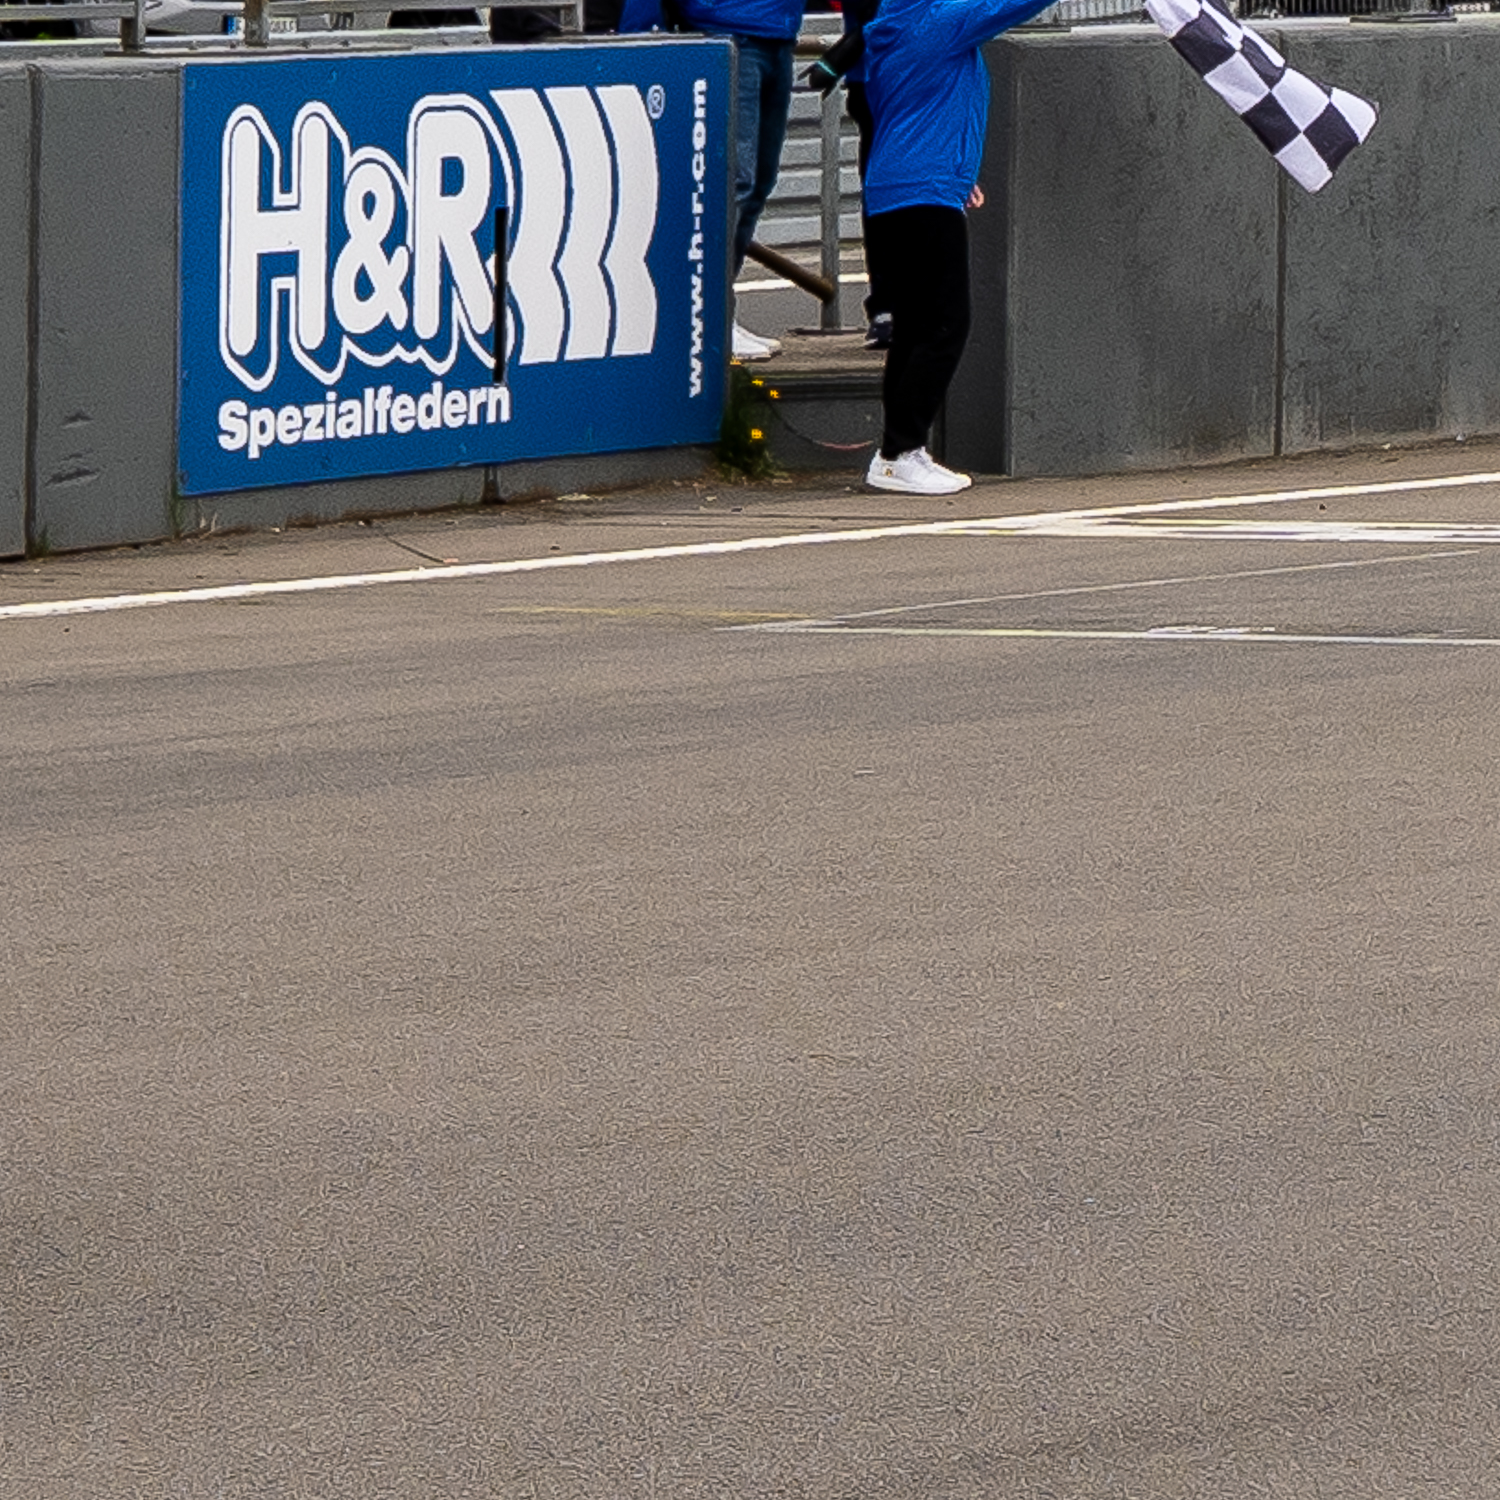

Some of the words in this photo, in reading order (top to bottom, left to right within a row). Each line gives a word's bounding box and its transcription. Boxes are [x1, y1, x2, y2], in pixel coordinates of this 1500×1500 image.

[220, 93, 515, 391] H&R
[688, 78, 708, 398] www.h-r.com
[217, 381, 512, 460] Spezialfedern
